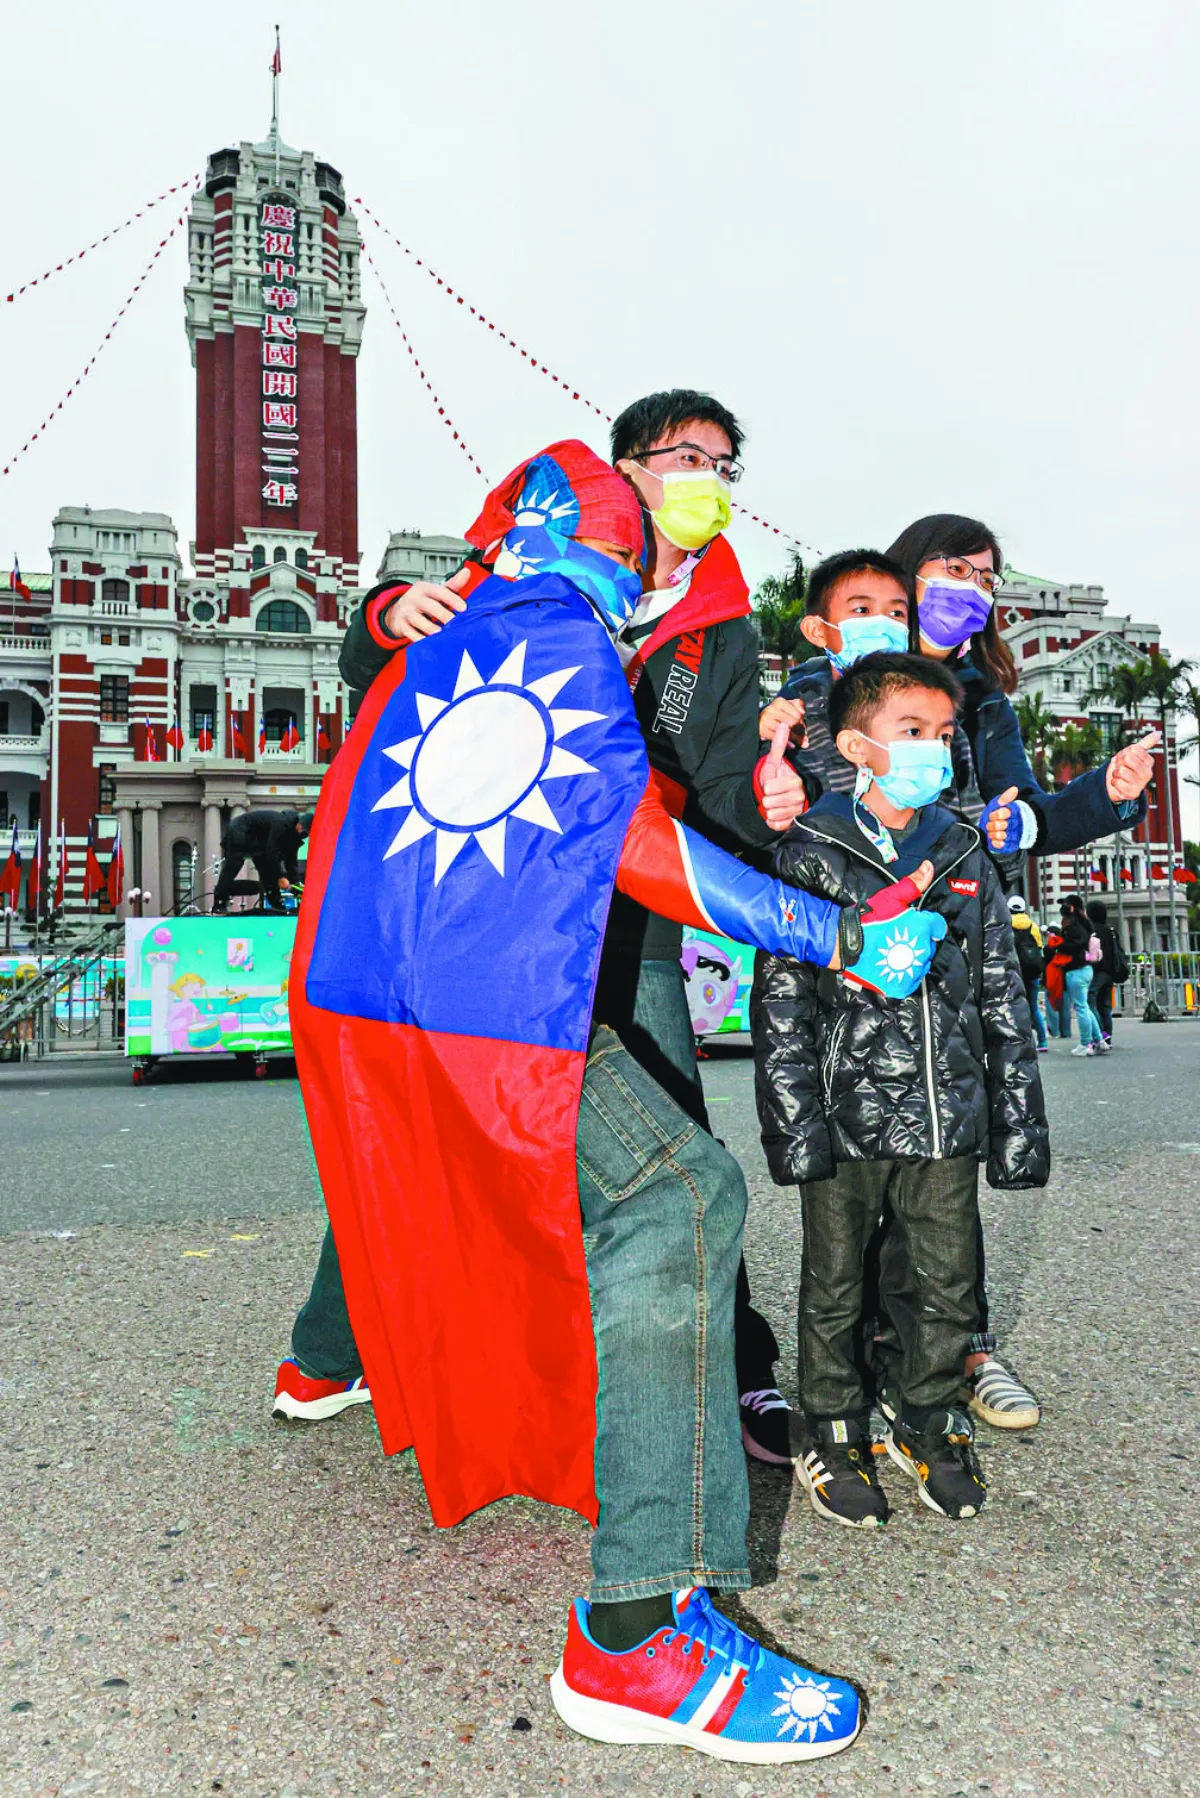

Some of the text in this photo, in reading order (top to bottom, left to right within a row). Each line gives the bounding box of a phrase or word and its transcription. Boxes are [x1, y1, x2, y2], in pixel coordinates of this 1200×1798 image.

[260, 204, 299, 505] 慶祝中華民國開國一一一年
[652, 663, 698, 734] REAL
